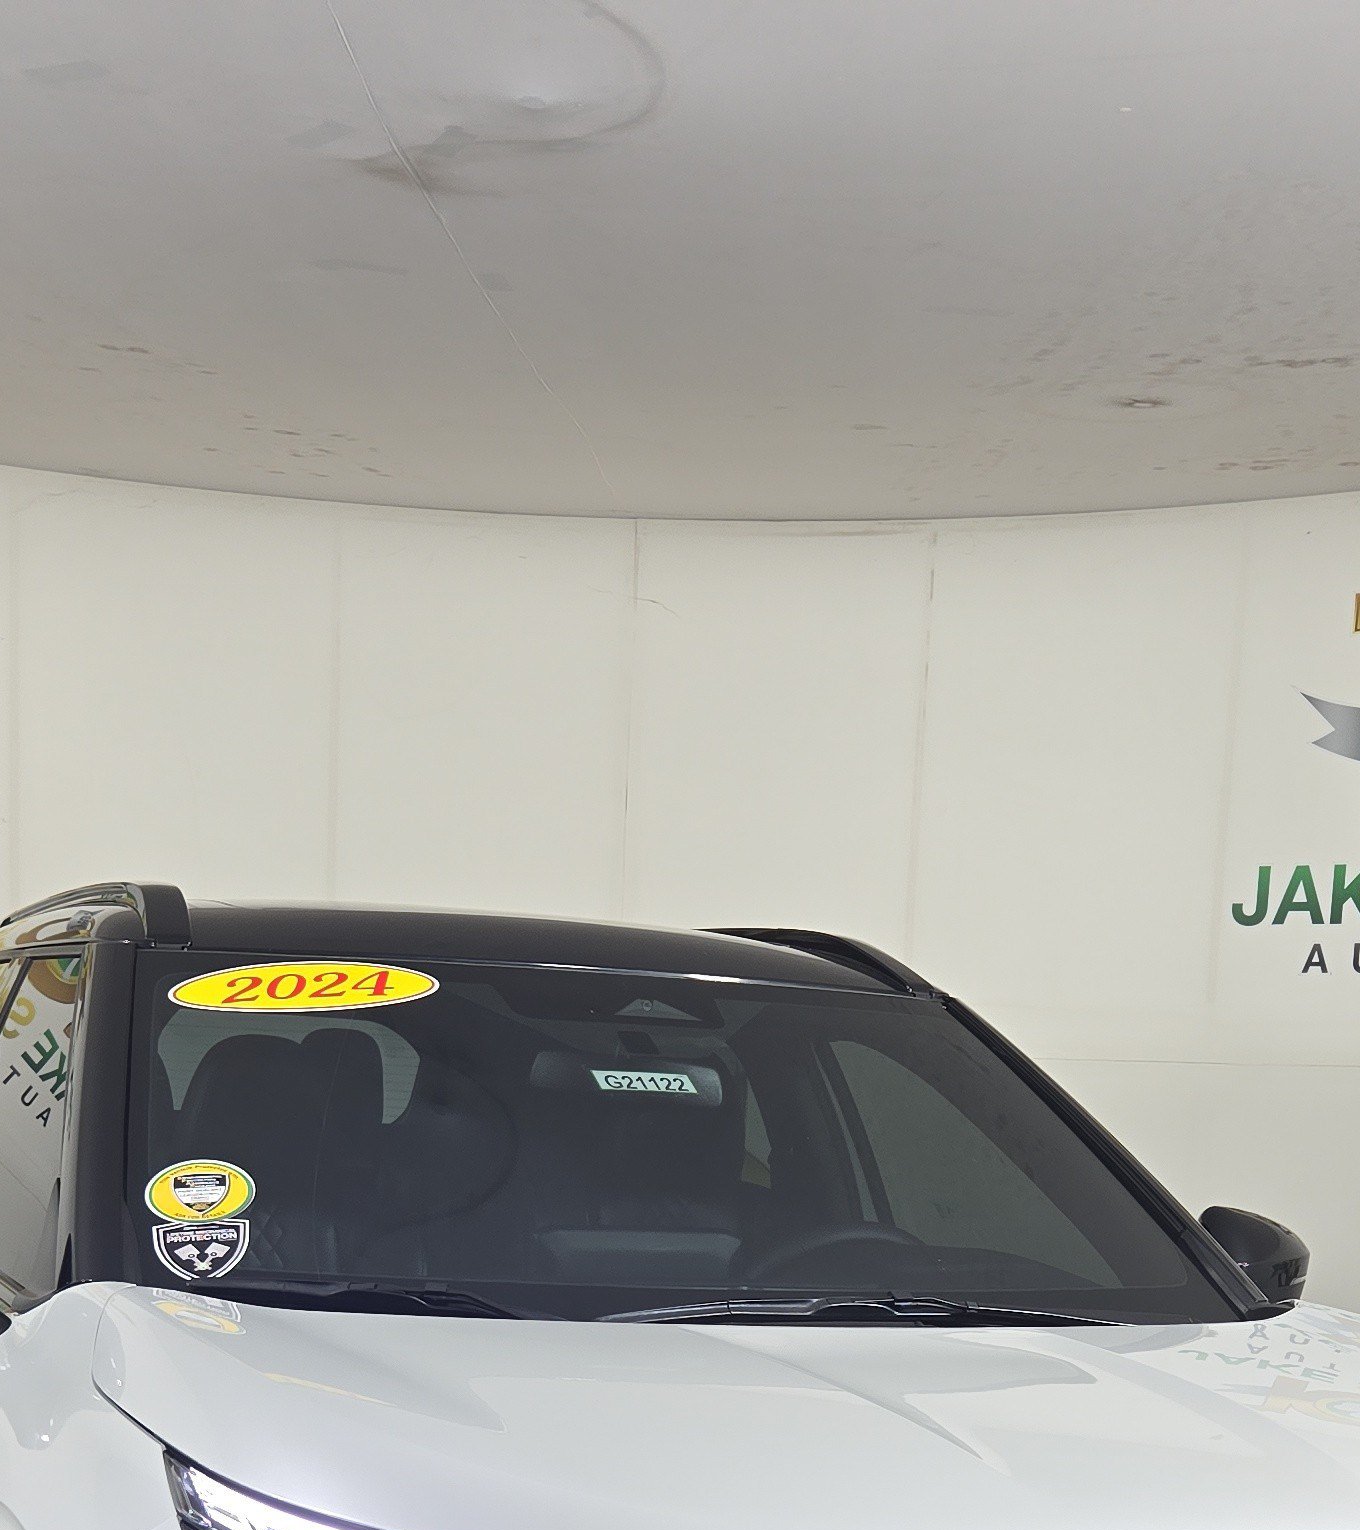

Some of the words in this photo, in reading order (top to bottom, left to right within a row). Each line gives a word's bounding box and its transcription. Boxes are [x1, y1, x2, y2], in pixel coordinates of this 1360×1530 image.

[221, 970, 395, 1004] 2024
[604, 1074, 690, 1092] G21122
[166, 1232, 238, 1243] PROTECTION
